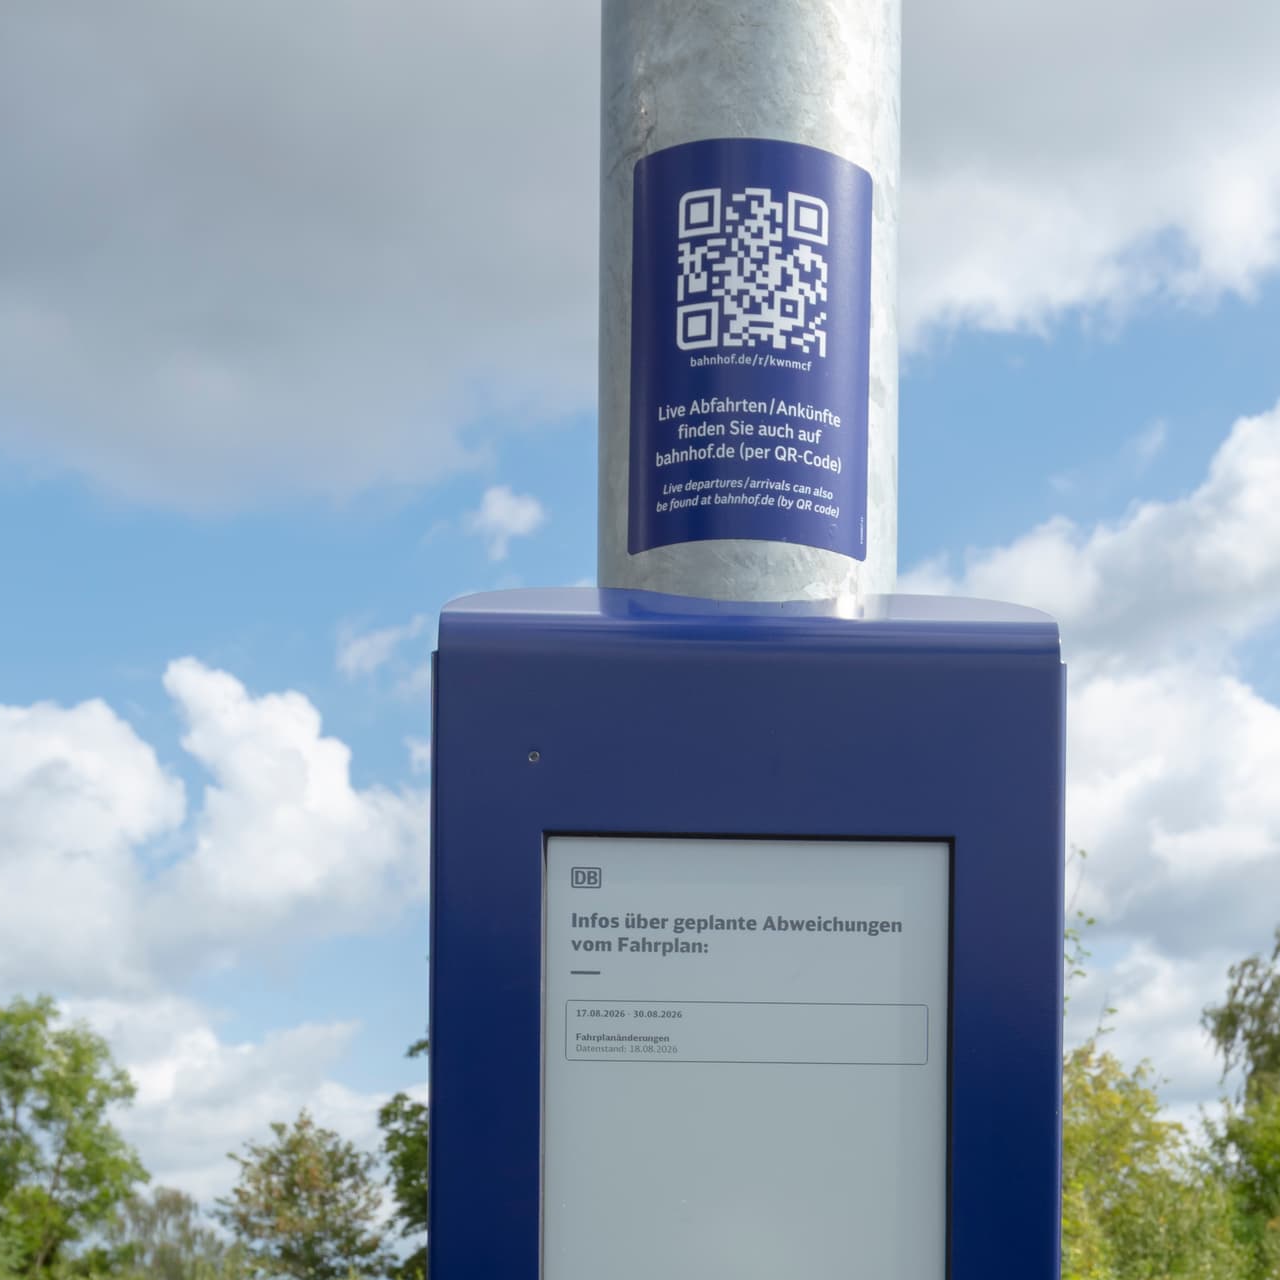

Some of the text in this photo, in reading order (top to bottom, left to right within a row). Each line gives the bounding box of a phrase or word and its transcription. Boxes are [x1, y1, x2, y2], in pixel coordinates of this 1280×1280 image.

[658, 404, 686, 422] Live
[678, 420, 822, 444] finden Sie auch auf
[655, 442, 842, 474] bahnhof.de (per QR-Code)
[663, 484, 683, 495] Live
[793, 484, 811, 495] can
[813, 487, 833, 500] also
[656, 493, 840, 519] be found at bahnhof.de (by QR code)
[574, 870, 599, 886] DB
[571, 912, 903, 937] Infos über geplante Abweichungen
[571, 936, 709, 957] vom Fahrplan:
[575, 1032, 670, 1044] Fahrplanänderungen
